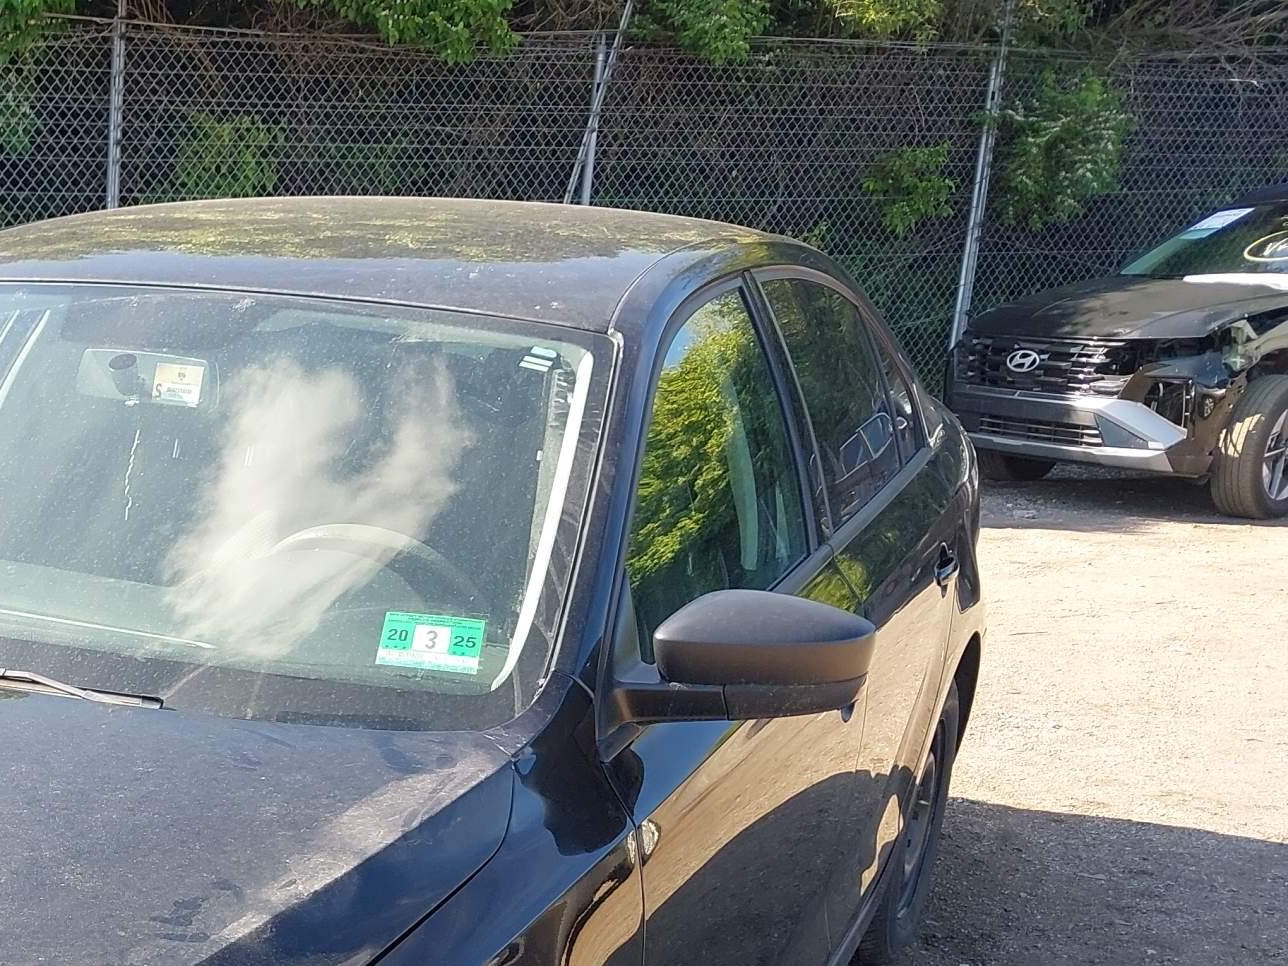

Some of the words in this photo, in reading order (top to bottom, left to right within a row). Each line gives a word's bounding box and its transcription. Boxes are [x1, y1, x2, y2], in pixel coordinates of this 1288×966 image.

[386, 628, 409, 642] 20
[425, 630, 438, 650] 3
[452, 635, 478, 649] 25
